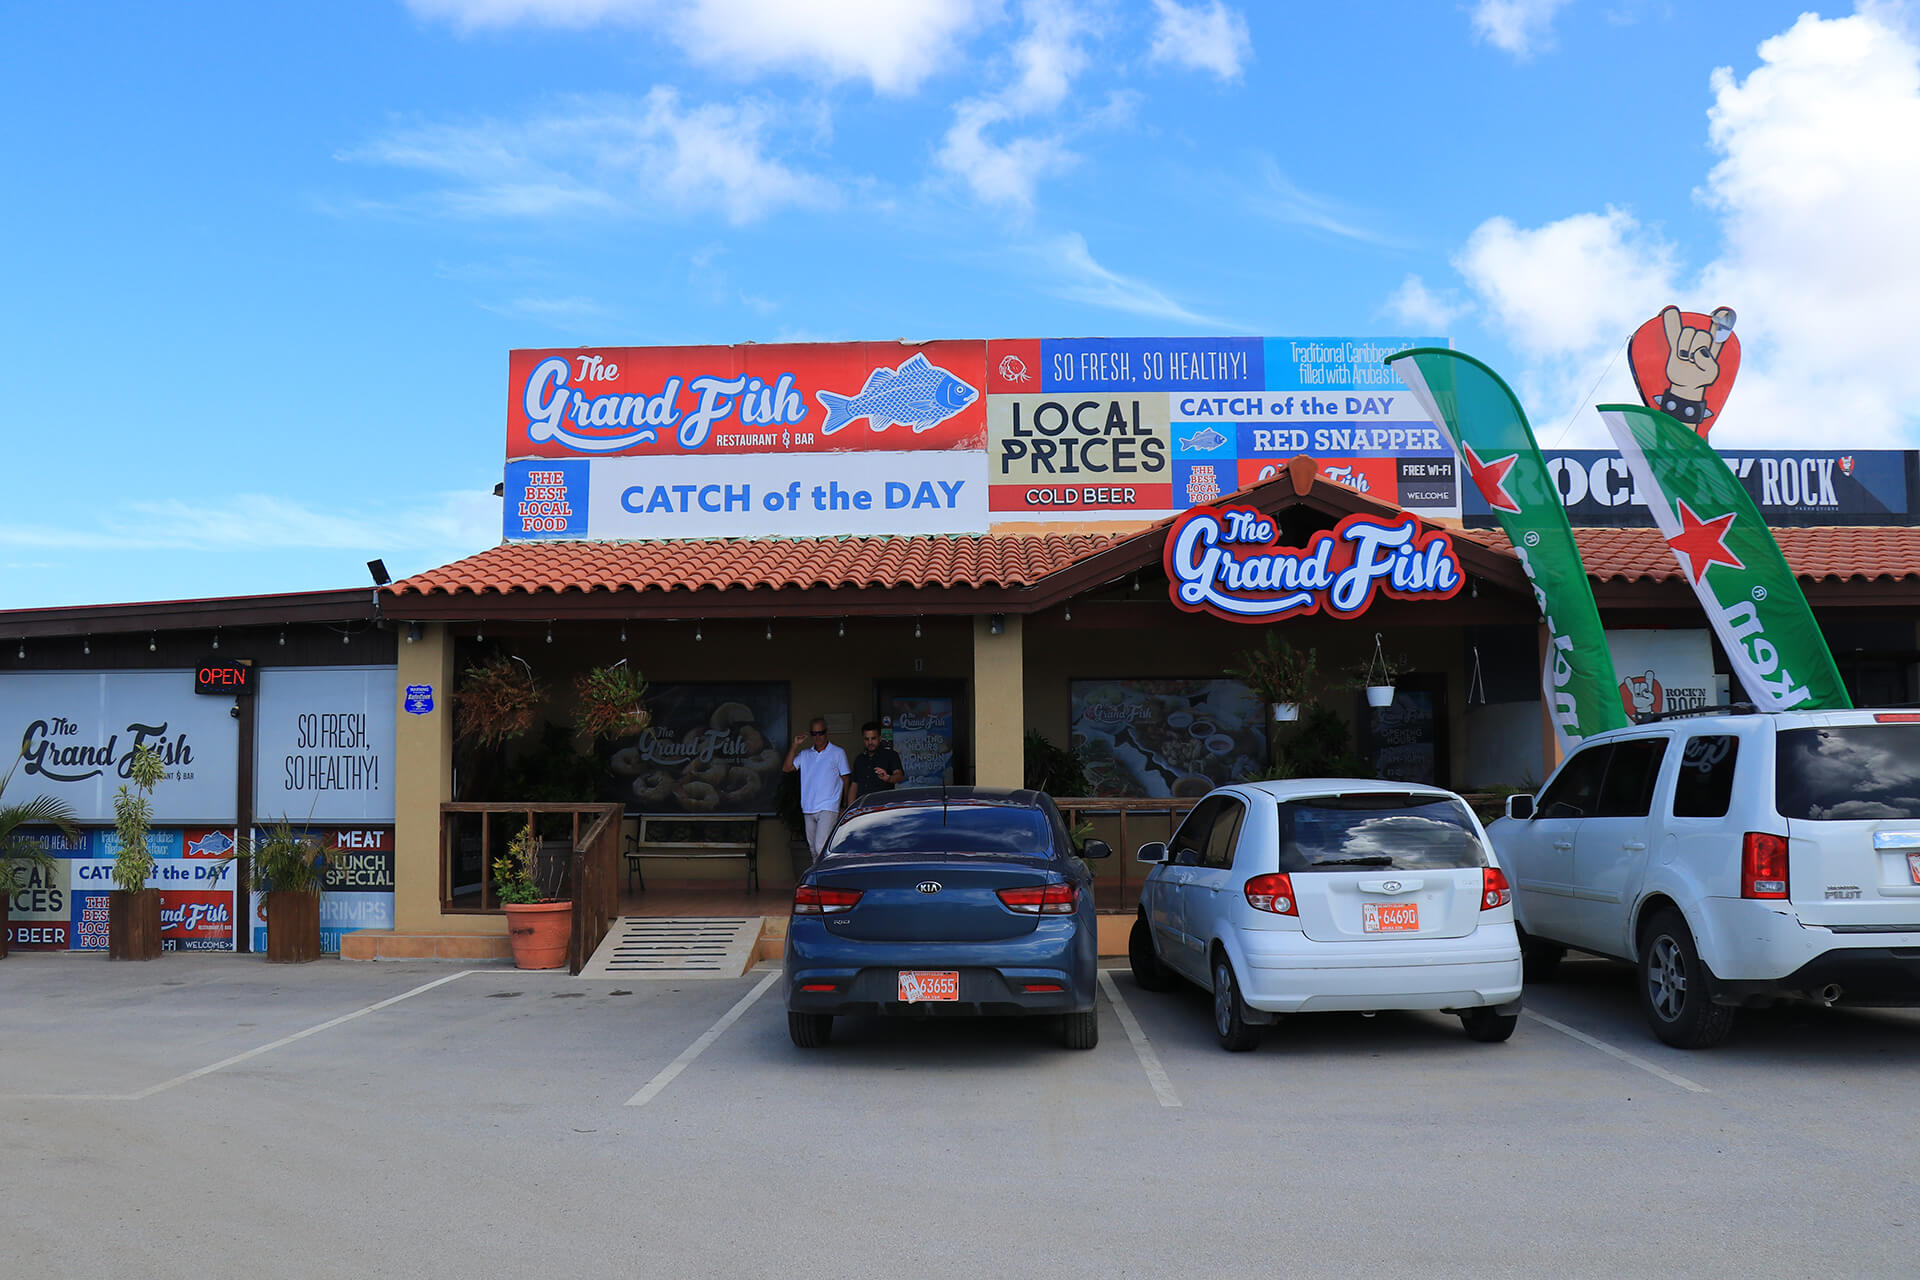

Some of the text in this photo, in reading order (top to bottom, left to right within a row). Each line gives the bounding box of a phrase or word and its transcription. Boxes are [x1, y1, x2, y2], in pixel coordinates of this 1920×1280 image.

[1290, 341, 1345, 363] Traditional
[574, 355, 619, 382] The
[1053, 351, 1247, 384] SO FRESH, SO HEALTHY!
[1299, 363, 1325, 384] filled
[1325, 363, 1350, 384] with
[525, 358, 806, 451] Grand Fish
[1180, 397, 1394, 417] CATCH of the DAY
[1012, 401, 1153, 437] LOCAL
[716, 433, 777, 447] RESTAURANT
[795, 432, 815, 445] BAR
[1253, 428, 1442, 452] RED SNAPPER
[1001, 436, 1166, 474] PRICES
[530, 472, 563, 485] THE
[1192, 466, 1214, 475] THE
[1402, 464, 1452, 476] FREE WI-FI
[1190, 475, 1216, 484] BEST
[1759, 458, 1838, 506] ROCK
[526, 487, 567, 500] BEST
[620, 480, 965, 514] CATCH of the DAY
[1026, 486, 1136, 504] COLD BEER
[1187, 484, 1220, 493] LOCAL
[1407, 491, 1449, 500] WELCOME
[520, 502, 572, 516] LOCAL
[523, 518, 566, 531] FOOD
[1224, 512, 1273, 541] The
[1175, 516, 1458, 614] Grand Fish
[199, 668, 246, 685] OPEN
[50, 717, 78, 736] The
[297, 713, 370, 751] SO FRESH,
[656, 727, 675, 738] The
[22, 720, 194, 782] Grand Fish
[639, 727, 748, 766] Grand Fish
[285, 755, 379, 790] SO HEALTHY!
[337, 831, 385, 848] MEAT
[334, 855, 386, 870] LUNCH
[79, 866, 113, 880] CAT
[163, 865, 190, 880] the
[194, 866, 230, 880] DAY
[326, 870, 394, 886] SPECIAL
[920, 884, 937, 892] KIA
[1824, 891, 1863, 900] PILOT
[83, 910, 110, 920] BES
[185, 903, 229, 930] Fish
[319, 901, 387, 920] HRIMPS
[1383, 909, 1416, 925] 64690
[17, 928, 65, 943] BEER
[78, 922, 110, 933] LOCA
[82, 935, 110, 947] FOO
[920, 978, 955, 993] 63655
